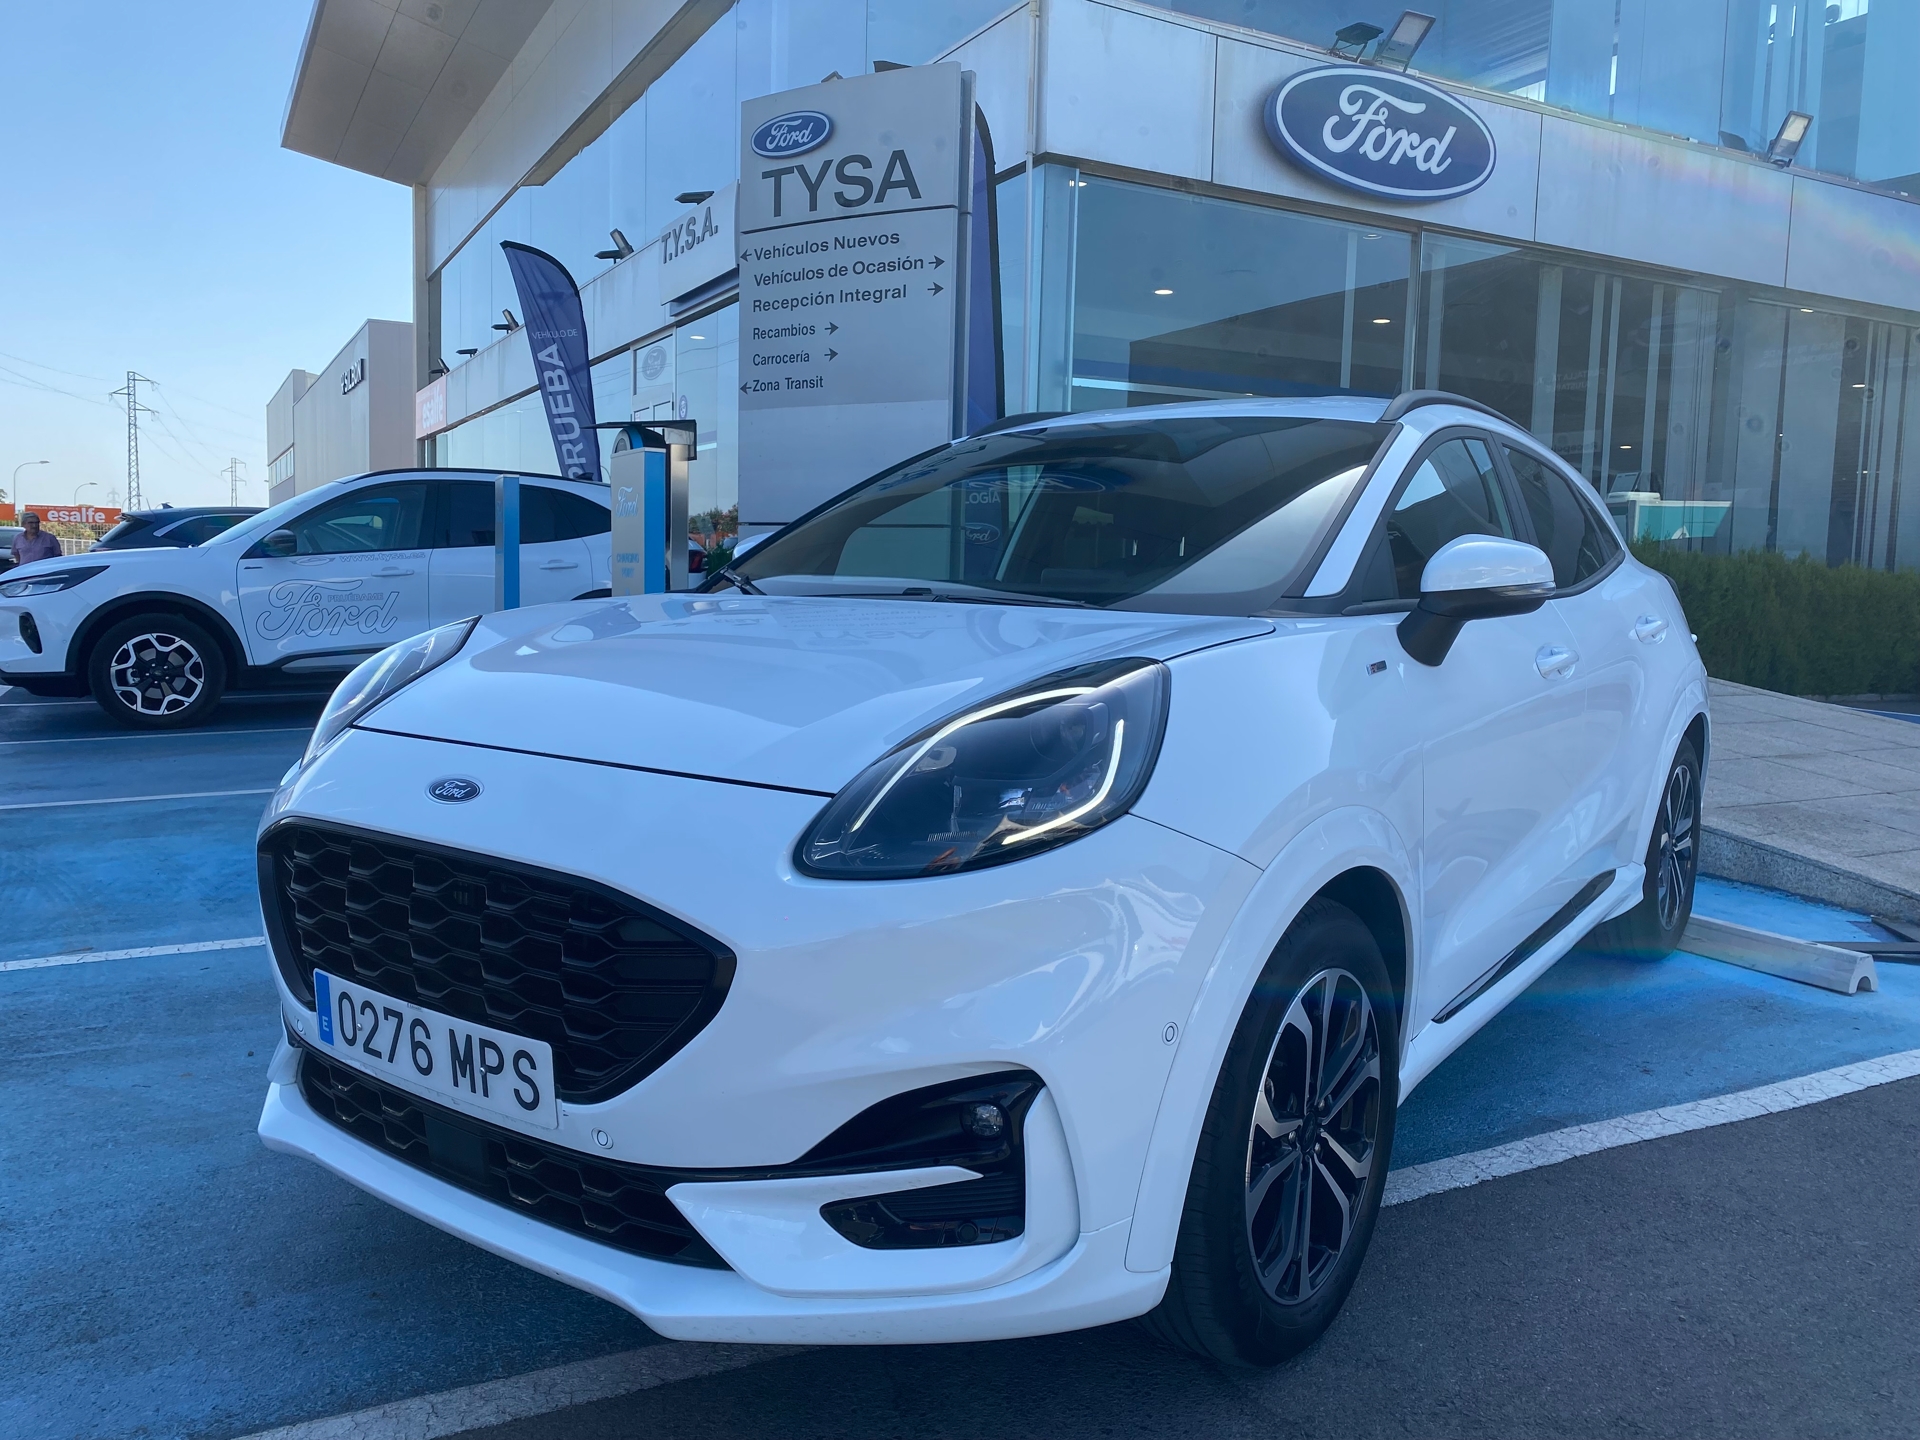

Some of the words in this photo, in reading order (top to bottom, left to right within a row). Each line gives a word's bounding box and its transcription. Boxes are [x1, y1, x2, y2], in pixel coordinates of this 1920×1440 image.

[766, 119, 812, 150] Ford
[1322, 84, 1457, 175] Ford
[761, 149, 922, 218] TYSA
[661, 206, 718, 265] T.Y.S.A.
[754, 239, 829, 262] Vehículos
[834, 231, 900, 250] Nuevos
[754, 264, 825, 287] Vehículos
[828, 263, 849, 279] de
[852, 256, 924, 275] Ocasión
[752, 291, 835, 313] Recepción
[839, 284, 907, 304] Integral
[752, 323, 816, 341] Recambios
[752, 350, 810, 367] Carrocería
[752, 380, 780, 393] Zona
[785, 376, 824, 391] Transit
[47, 507, 105, 523] esalfe
[616, 486, 638, 518] Ford
[340, 551, 426, 563] www.tysa.es
[256, 579, 400, 640] Ford
[435, 780, 471, 798] Ford
[322, 1016, 330, 1032] E
[338, 991, 433, 1077] 0276
[449, 1028, 541, 1111] MPS
